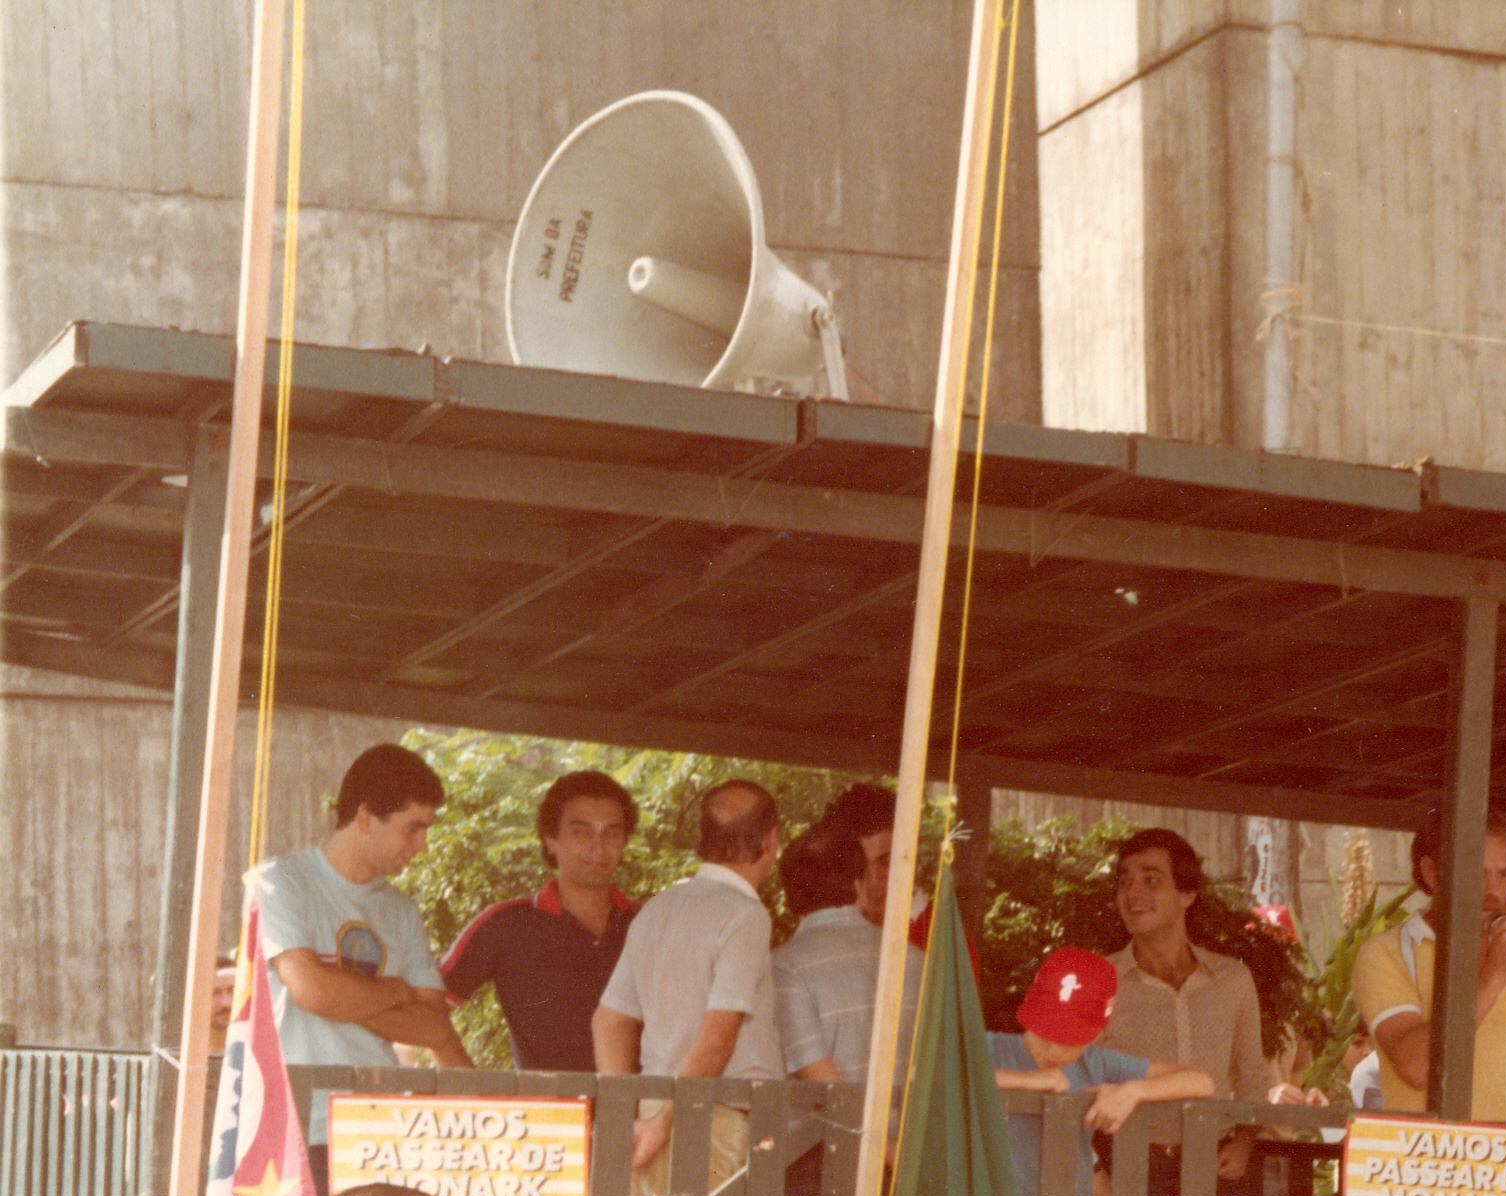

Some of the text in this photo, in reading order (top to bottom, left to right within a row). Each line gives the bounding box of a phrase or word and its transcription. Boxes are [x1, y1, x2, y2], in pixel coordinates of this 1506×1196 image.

[558, 210, 593, 303] PREFEITURA
[392, 1109, 528, 1140] VAMOS
[352, 1140, 565, 1172] PASSEAR DE
[1364, 1156, 1497, 1191] PASSEAR
